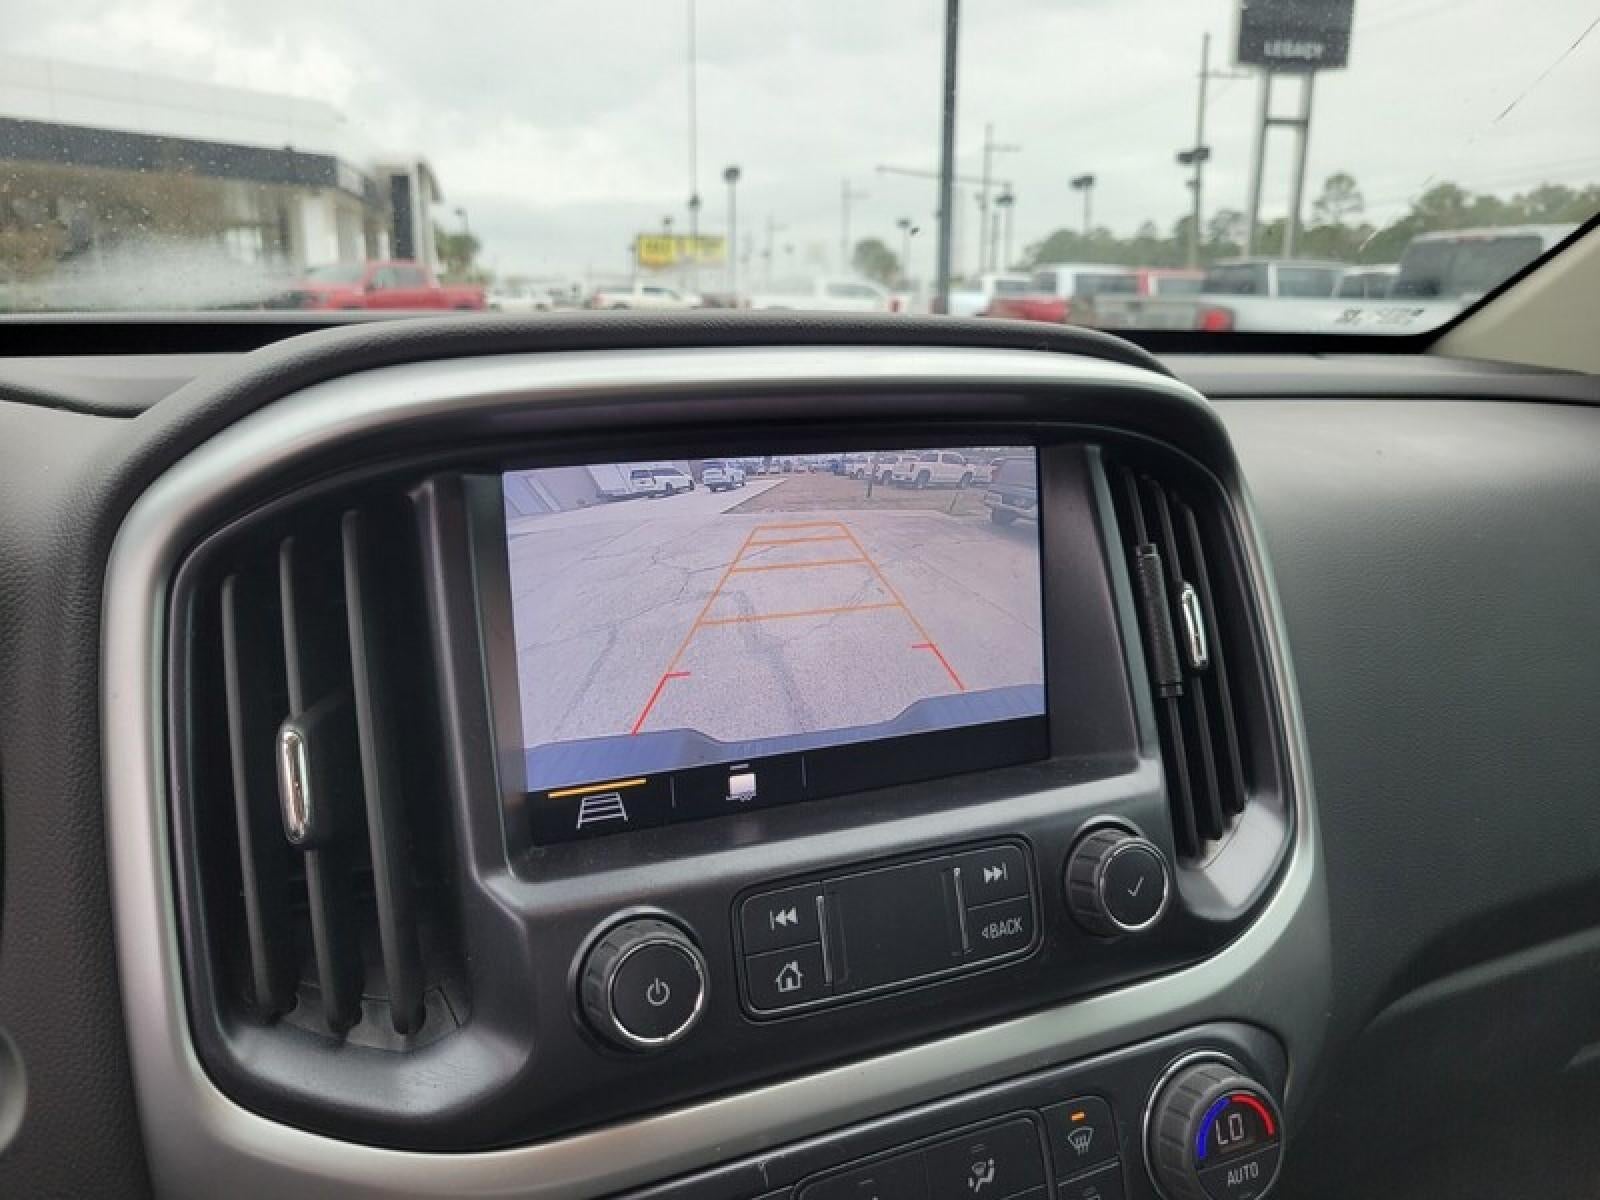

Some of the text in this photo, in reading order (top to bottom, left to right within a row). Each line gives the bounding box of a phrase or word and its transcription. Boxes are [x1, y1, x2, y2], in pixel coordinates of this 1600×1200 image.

[1262, 40, 1324, 60] LEGACY
[989, 917, 1023, 939] BACK
[1215, 1113, 1244, 1145] LO
[1227, 1161, 1259, 1187] AUTO
